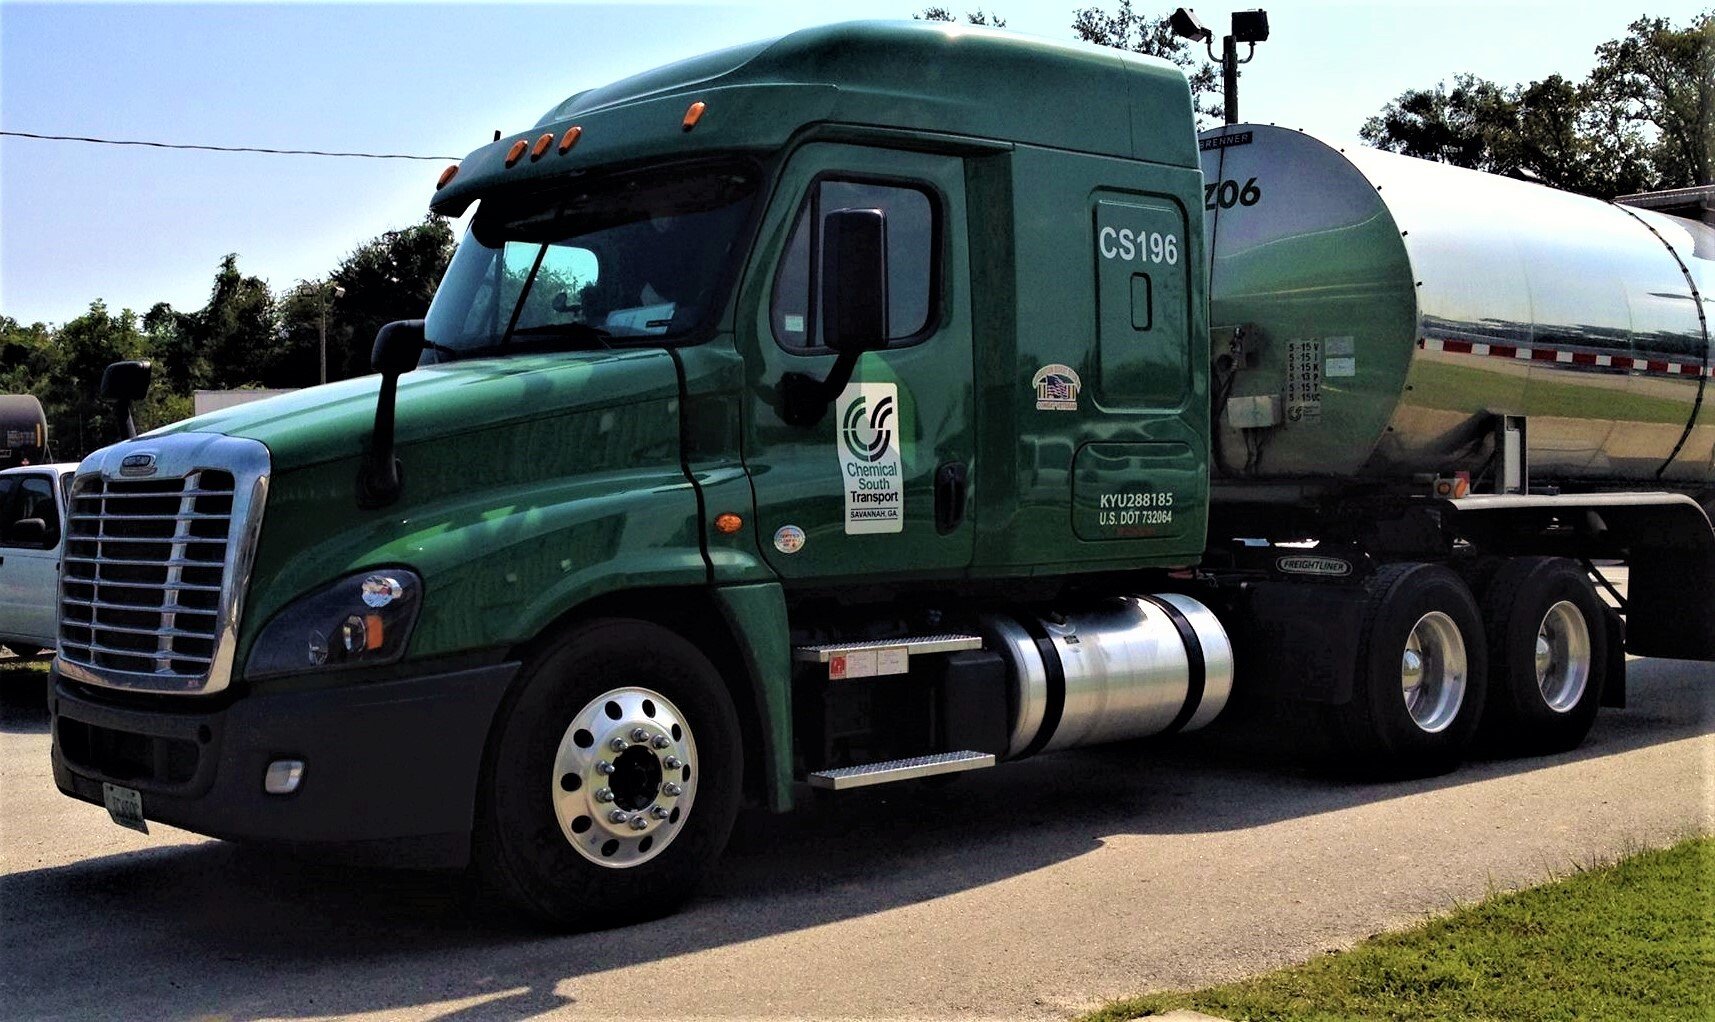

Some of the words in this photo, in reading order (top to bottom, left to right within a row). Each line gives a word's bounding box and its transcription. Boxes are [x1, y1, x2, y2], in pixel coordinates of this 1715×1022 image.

[1200, 134, 1248, 149] BRENNER
[1100, 226, 1178, 265] CS196
[847, 461, 898, 477] Chemical
[858, 477, 890, 490] South
[850, 490, 899, 505] Transport
[1100, 492, 1173, 508] KYU288185
[1099, 511, 1118, 525] U.S.
[1120, 510, 1140, 525] DOT
[1142, 510, 1172, 524] 732064
[1283, 560, 1344, 571] FREIGHTLINER
